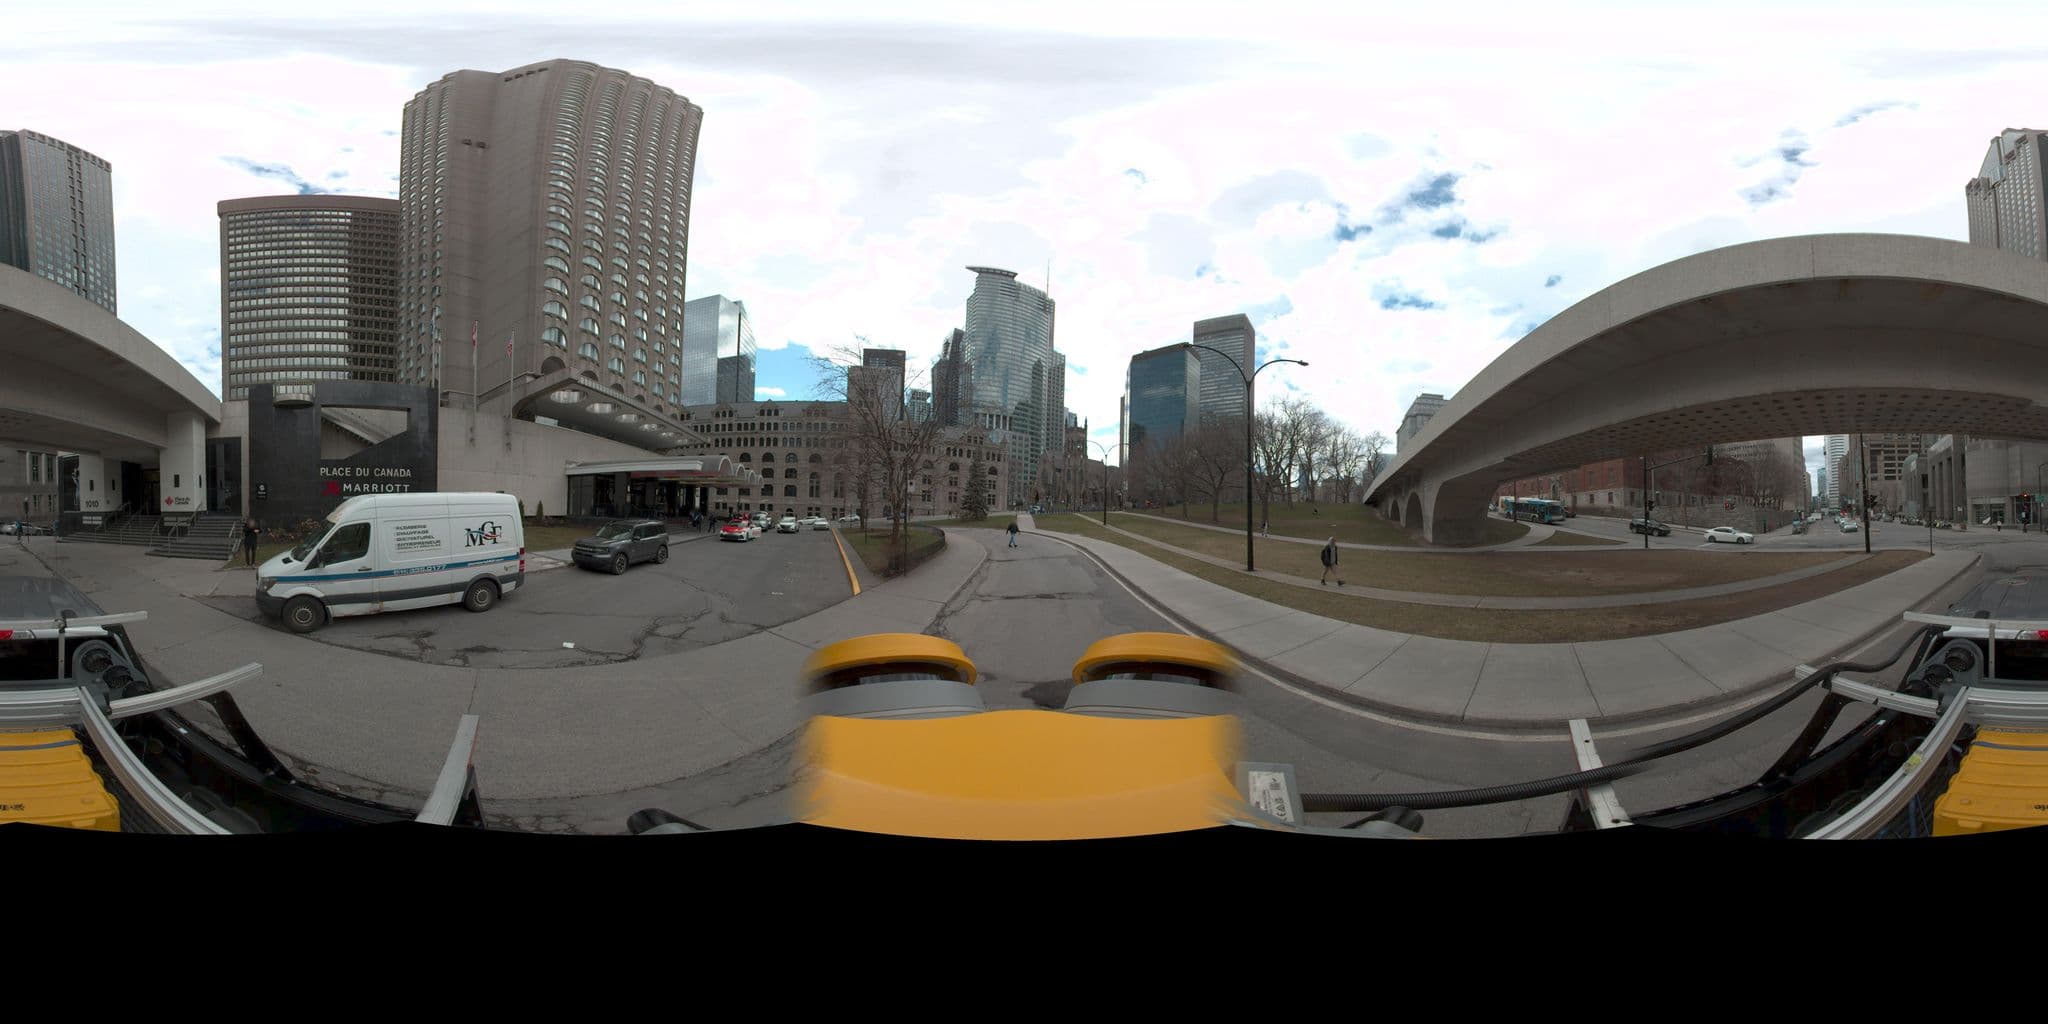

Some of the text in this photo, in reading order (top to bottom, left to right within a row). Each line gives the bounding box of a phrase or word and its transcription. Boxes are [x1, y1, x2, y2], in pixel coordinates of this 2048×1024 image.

[320, 467, 412, 477] PLACE DU CANADA
[343, 483, 410, 493] MARRIOTT
[464, 521, 502, 547] MGF
